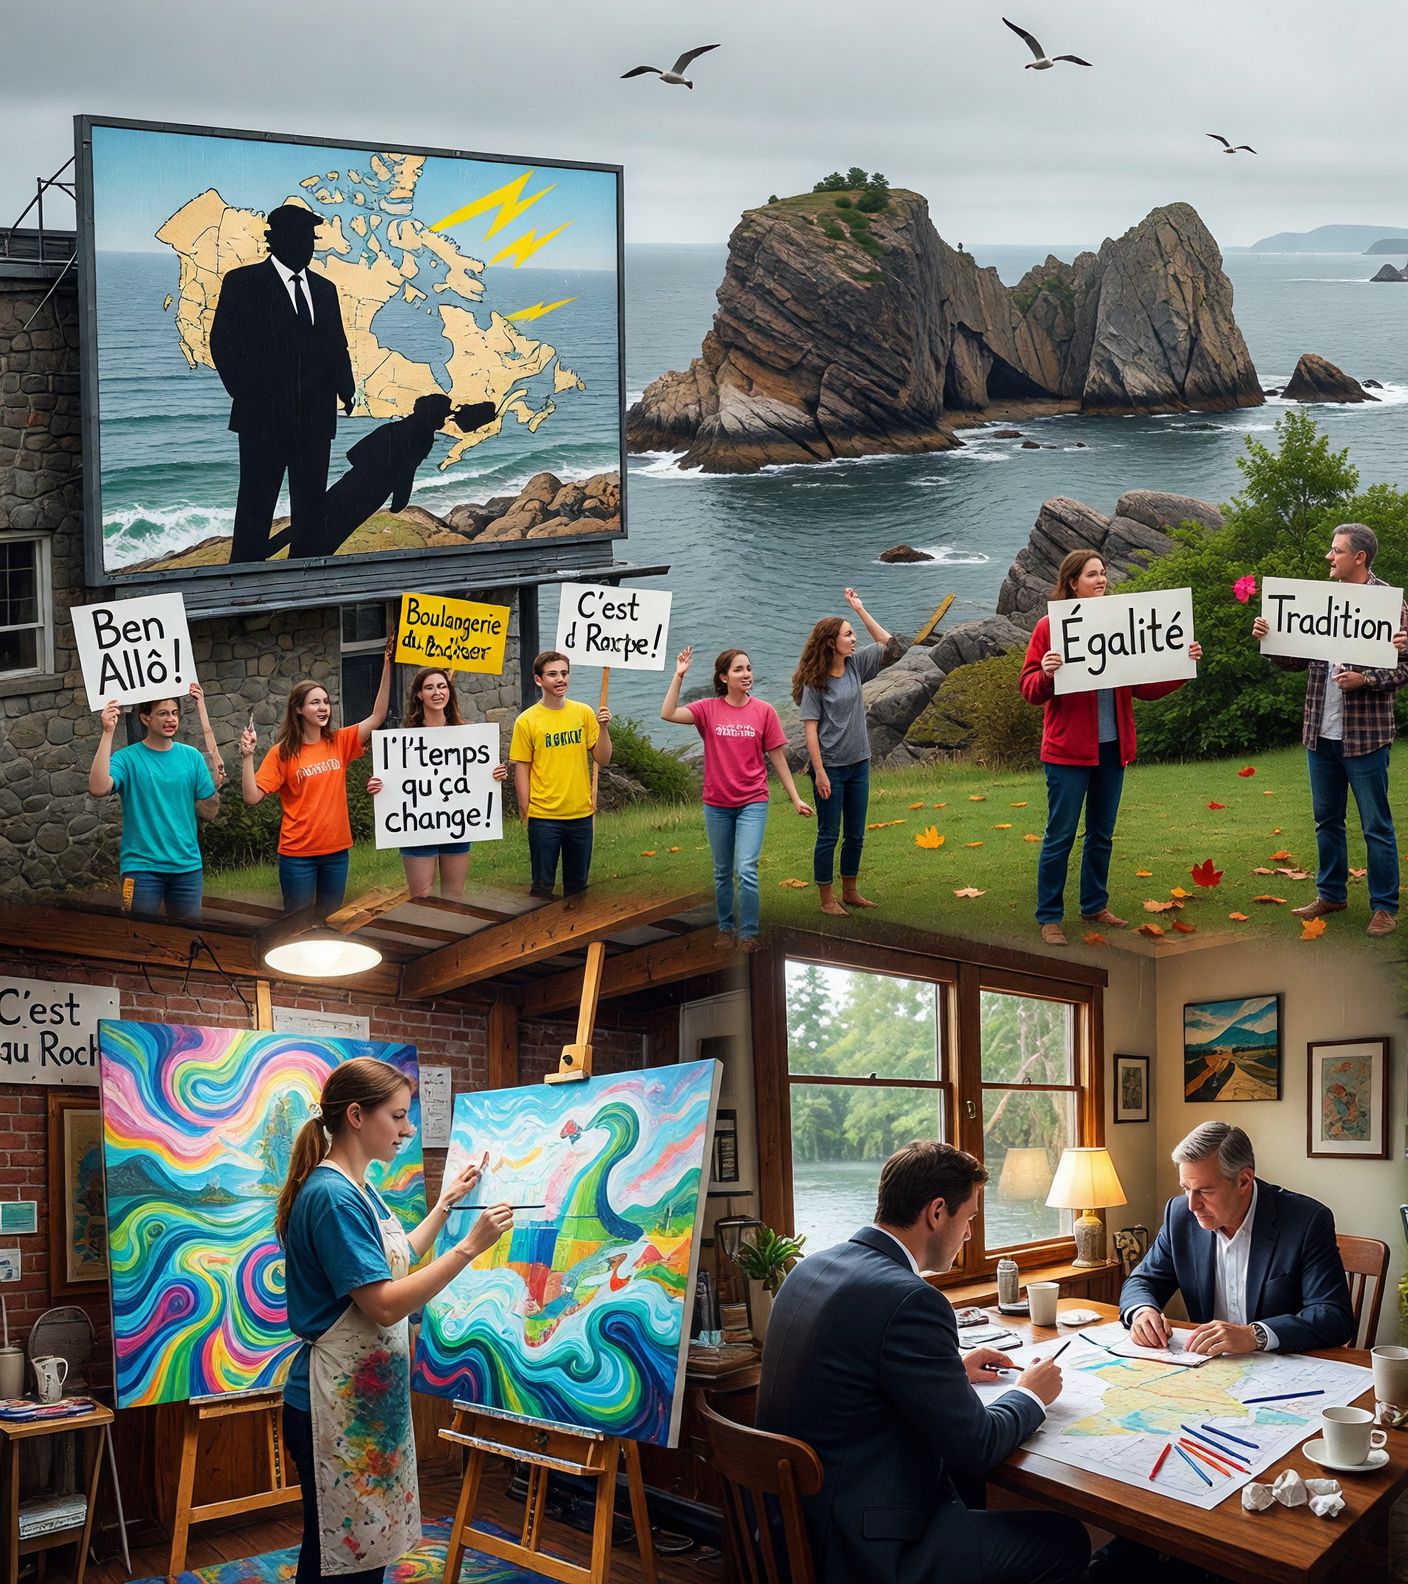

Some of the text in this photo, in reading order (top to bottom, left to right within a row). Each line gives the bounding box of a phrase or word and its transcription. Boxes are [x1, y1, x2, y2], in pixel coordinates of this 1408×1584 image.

[91, 608, 165, 650] Ben
[406, 597, 502, 642] Boulangerie
[577, 590, 641, 622] C'est
[1267, 594, 1393, 643] Tradition
[1061, 603, 1184, 676] Égalité
[98, 638, 182, 696] Allô!
[384, 791, 494, 840] change!
[0, 987, 81, 1027] C'est
